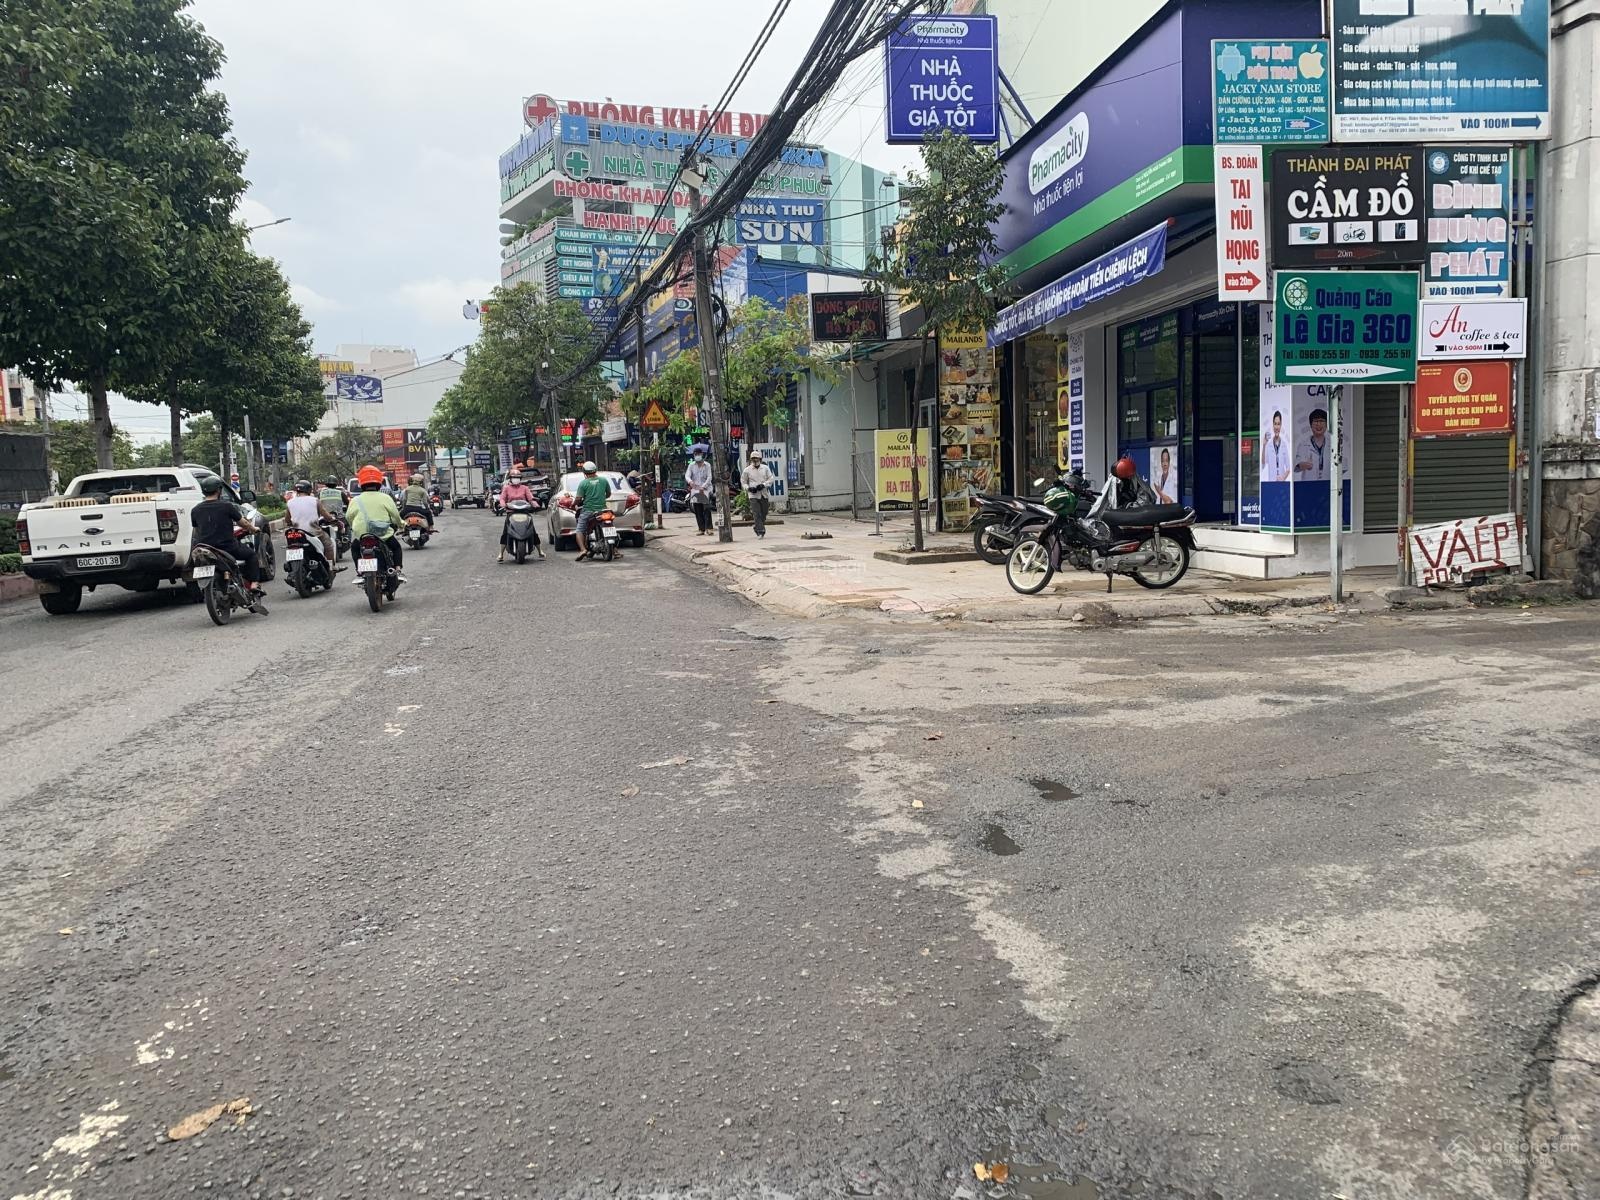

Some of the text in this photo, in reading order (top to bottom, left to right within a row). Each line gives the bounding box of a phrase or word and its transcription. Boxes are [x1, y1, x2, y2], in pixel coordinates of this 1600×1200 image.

[917, 22, 964, 35] Pharmacity
[1343, 44, 1353, 52] Gia
[922, 55, 962, 75] NHÀ
[1343, 61, 1359, 72] Nhận
[910, 77, 973, 101] THUỐC
[1223, 84, 1321, 94] JACKY NAM STORE
[1344, 80, 1353, 88] Gia
[1371, 80, 1382, 88] các
[908, 103, 976, 126] GIÁ TỐT
[1227, 115, 1256, 124] Jacky
[1483, 118, 1510, 128] 100M
[604, 152, 647, 176] NHÀ
[1032, 126, 1084, 186] Pharmacity
[1222, 157, 1235, 169] BS.
[1287, 153, 1412, 174] THÀNH ĐẠI PHÁT
[1454, 152, 1468, 162] CÔNG
[1470, 154, 1476, 162] TY
[1460, 166, 1469, 175] CƠ
[1470, 164, 1478, 174] KHÍ
[1491, 166, 1502, 176] TẠO
[1034, 196, 1045, 216] Nhà
[1046, 182, 1062, 208] thuốc
[1075, 168, 1083, 189] lợi
[1231, 179, 1250, 199] TAI
[1287, 172, 1414, 219] CẦM ĐỒ
[1433, 180, 1502, 209] BÌNH
[741, 201, 814, 216] NHÀ THU
[1231, 205, 1252, 230] MŨI
[741, 218, 813, 242] SƠN
[1428, 214, 1507, 243] HƯNG
[1226, 240, 1259, 265] HỌNG
[1430, 248, 1504, 277] PHÁT
[1105, 256, 1128, 282] CHÊNH
[1128, 247, 1148, 274] LỆCH
[1228, 276, 1239, 286] vào
[1450, 287, 1474, 295] 100M
[1316, 287, 1392, 309] Quảng Cáo
[1284, 314, 1411, 344] Lê Gia 360
[1429, 305, 1467, 338] An
[1460, 329, 1490, 341] coffee
[1502, 331, 1519, 339] tea
[887, 481, 897, 495] HẠ
[37, 536, 154, 551] RANGER
